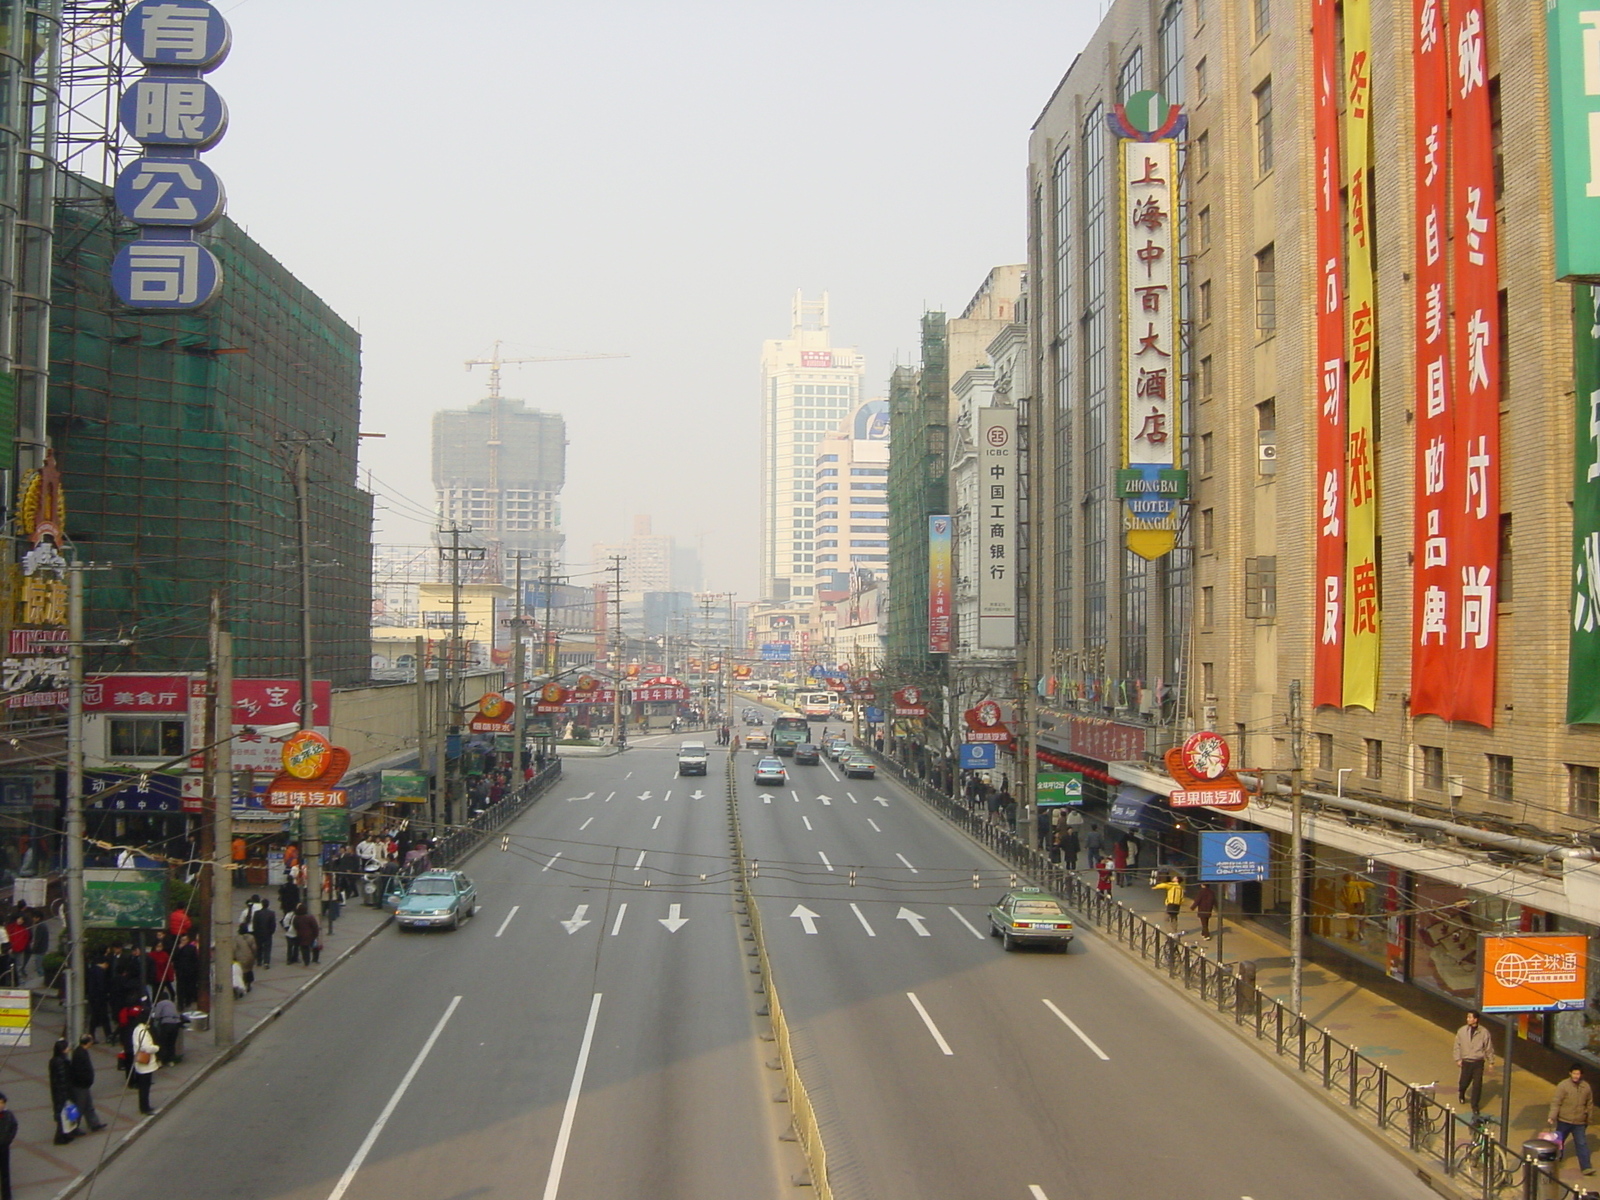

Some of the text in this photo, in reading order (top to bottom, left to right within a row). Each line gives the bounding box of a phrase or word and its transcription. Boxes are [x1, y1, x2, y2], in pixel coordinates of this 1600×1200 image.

[132, 4, 210, 303] 有限公司
[1131, 156, 1171, 443] 上海中百大酒店
[1125, 479, 1178, 493] ZHONGBAI
[1133, 500, 1172, 513] HOTEL
[990, 464, 1005, 580] 中国工商银行
[1123, 516, 1182, 530] SHANGHAI
[114, 691, 178, 705] 美食厅
[270, 791, 344, 806] 橙味汽水
[1172, 790, 1242, 805] 苹果味汽水
[1527, 952, 1577, 971] 全球通
